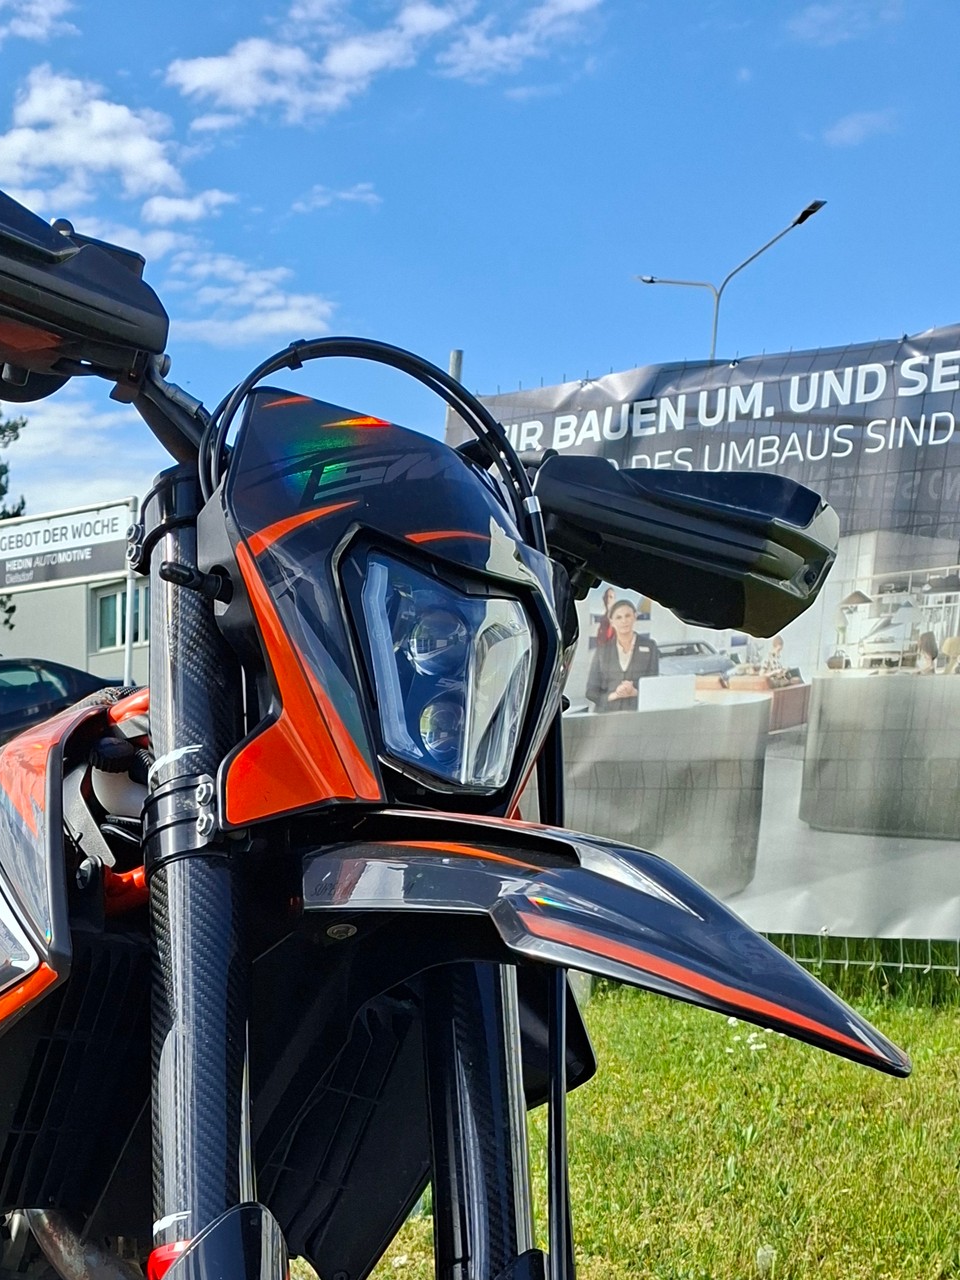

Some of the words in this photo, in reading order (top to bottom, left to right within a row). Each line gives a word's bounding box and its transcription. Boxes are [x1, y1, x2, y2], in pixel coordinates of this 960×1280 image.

[504, 420, 544, 452] IR
[552, 394, 686, 450] BAUEN
[698, 381, 775, 427] UM.
[790, 362, 887, 414] UND
[703, 424, 854, 472] UMBAUS
[865, 411, 955, 453] SIND
[43, 525, 68, 545] DER
[71, 517, 119, 539] WOCHE
[5, 557, 34, 572] HEDIN
[33, 547, 93, 568] AUTOMOTIVE
